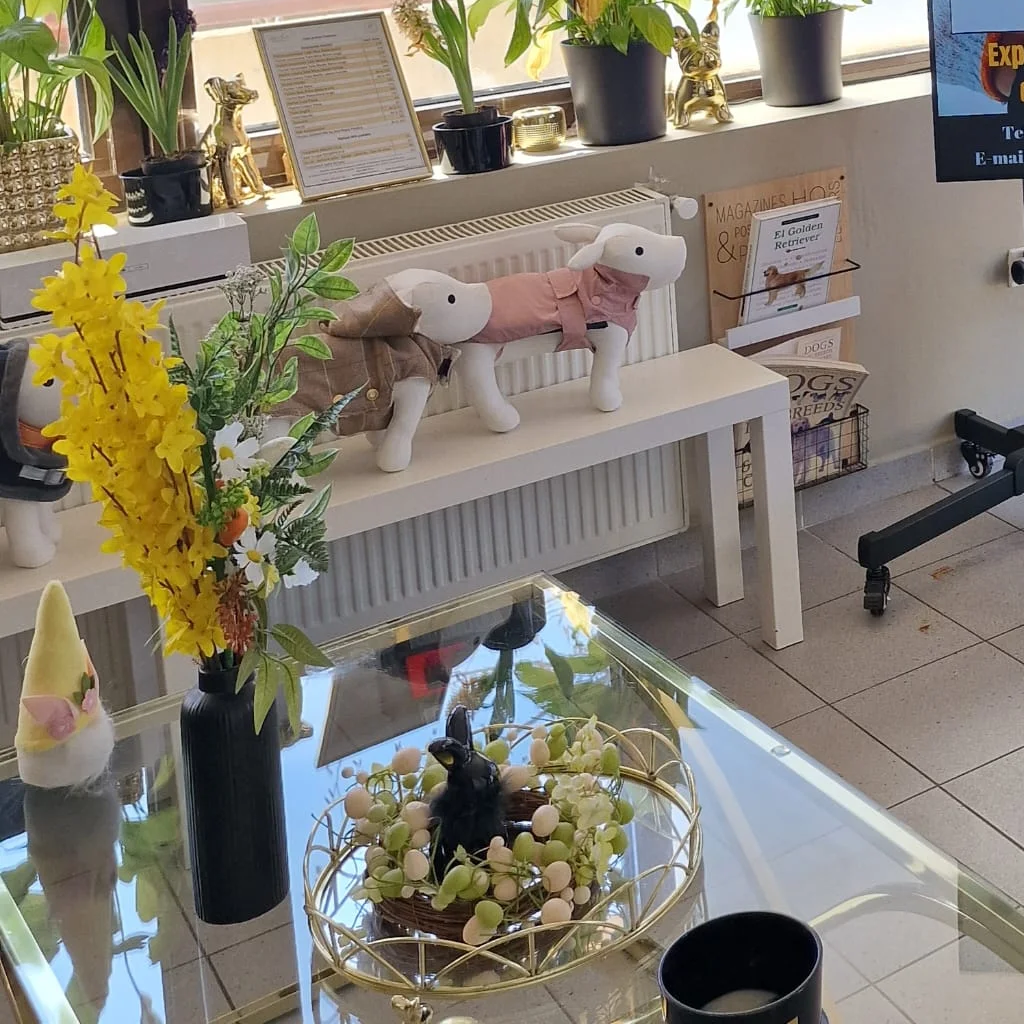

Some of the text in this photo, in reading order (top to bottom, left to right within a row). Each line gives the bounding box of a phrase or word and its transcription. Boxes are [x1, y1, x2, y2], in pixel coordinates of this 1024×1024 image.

[788, 222, 823, 237] Golden
[774, 233, 820, 251] Retriever
[804, 339, 834, 355] DOGS
[786, 373, 857, 394] OGS
[790, 401, 844, 419] REEDS
